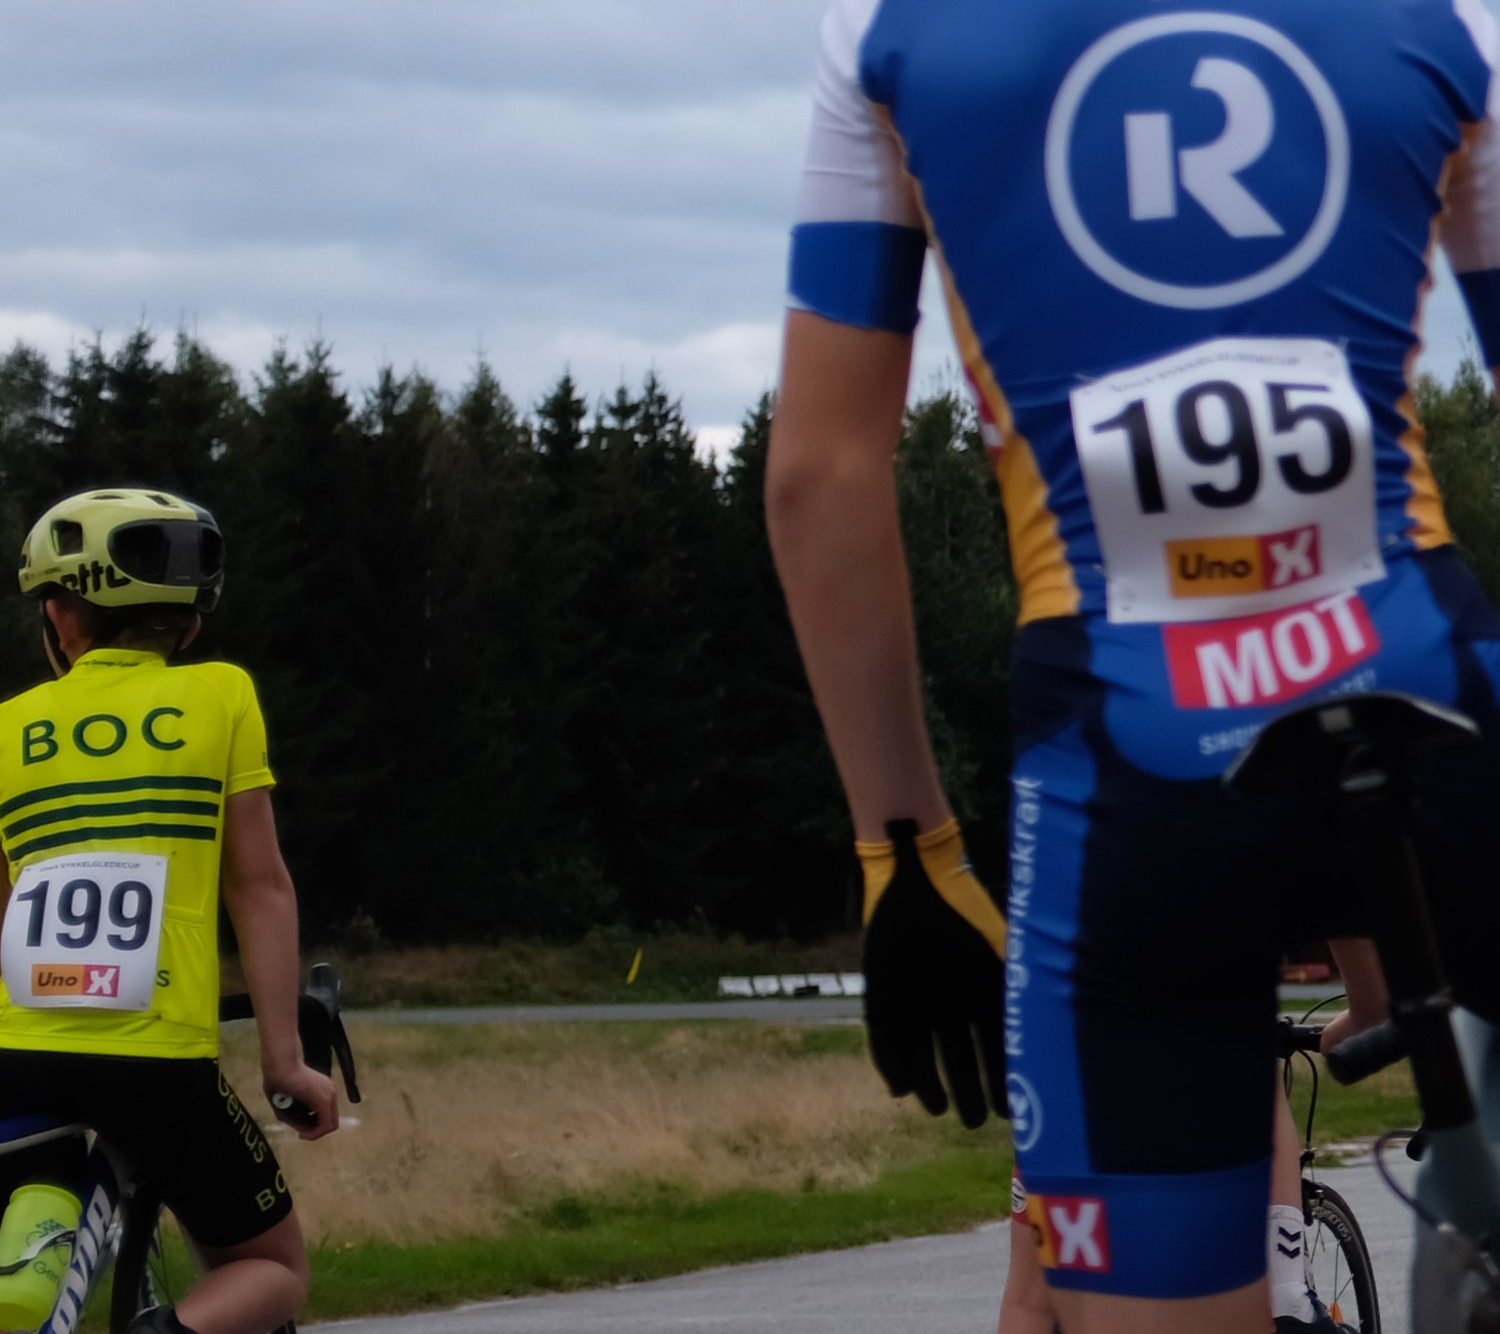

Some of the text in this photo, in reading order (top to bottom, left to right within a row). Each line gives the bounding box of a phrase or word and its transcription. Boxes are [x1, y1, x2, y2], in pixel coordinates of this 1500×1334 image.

[1092, 380, 1354, 514] 195
[1178, 527, 1315, 587] Uno X
[1196, 587, 1366, 709] MOT
[22, 706, 187, 766] BOC
[16, 878, 153, 951] 199
[37, 968, 117, 995] Uno X
[1049, 1202, 1103, 1267] X
